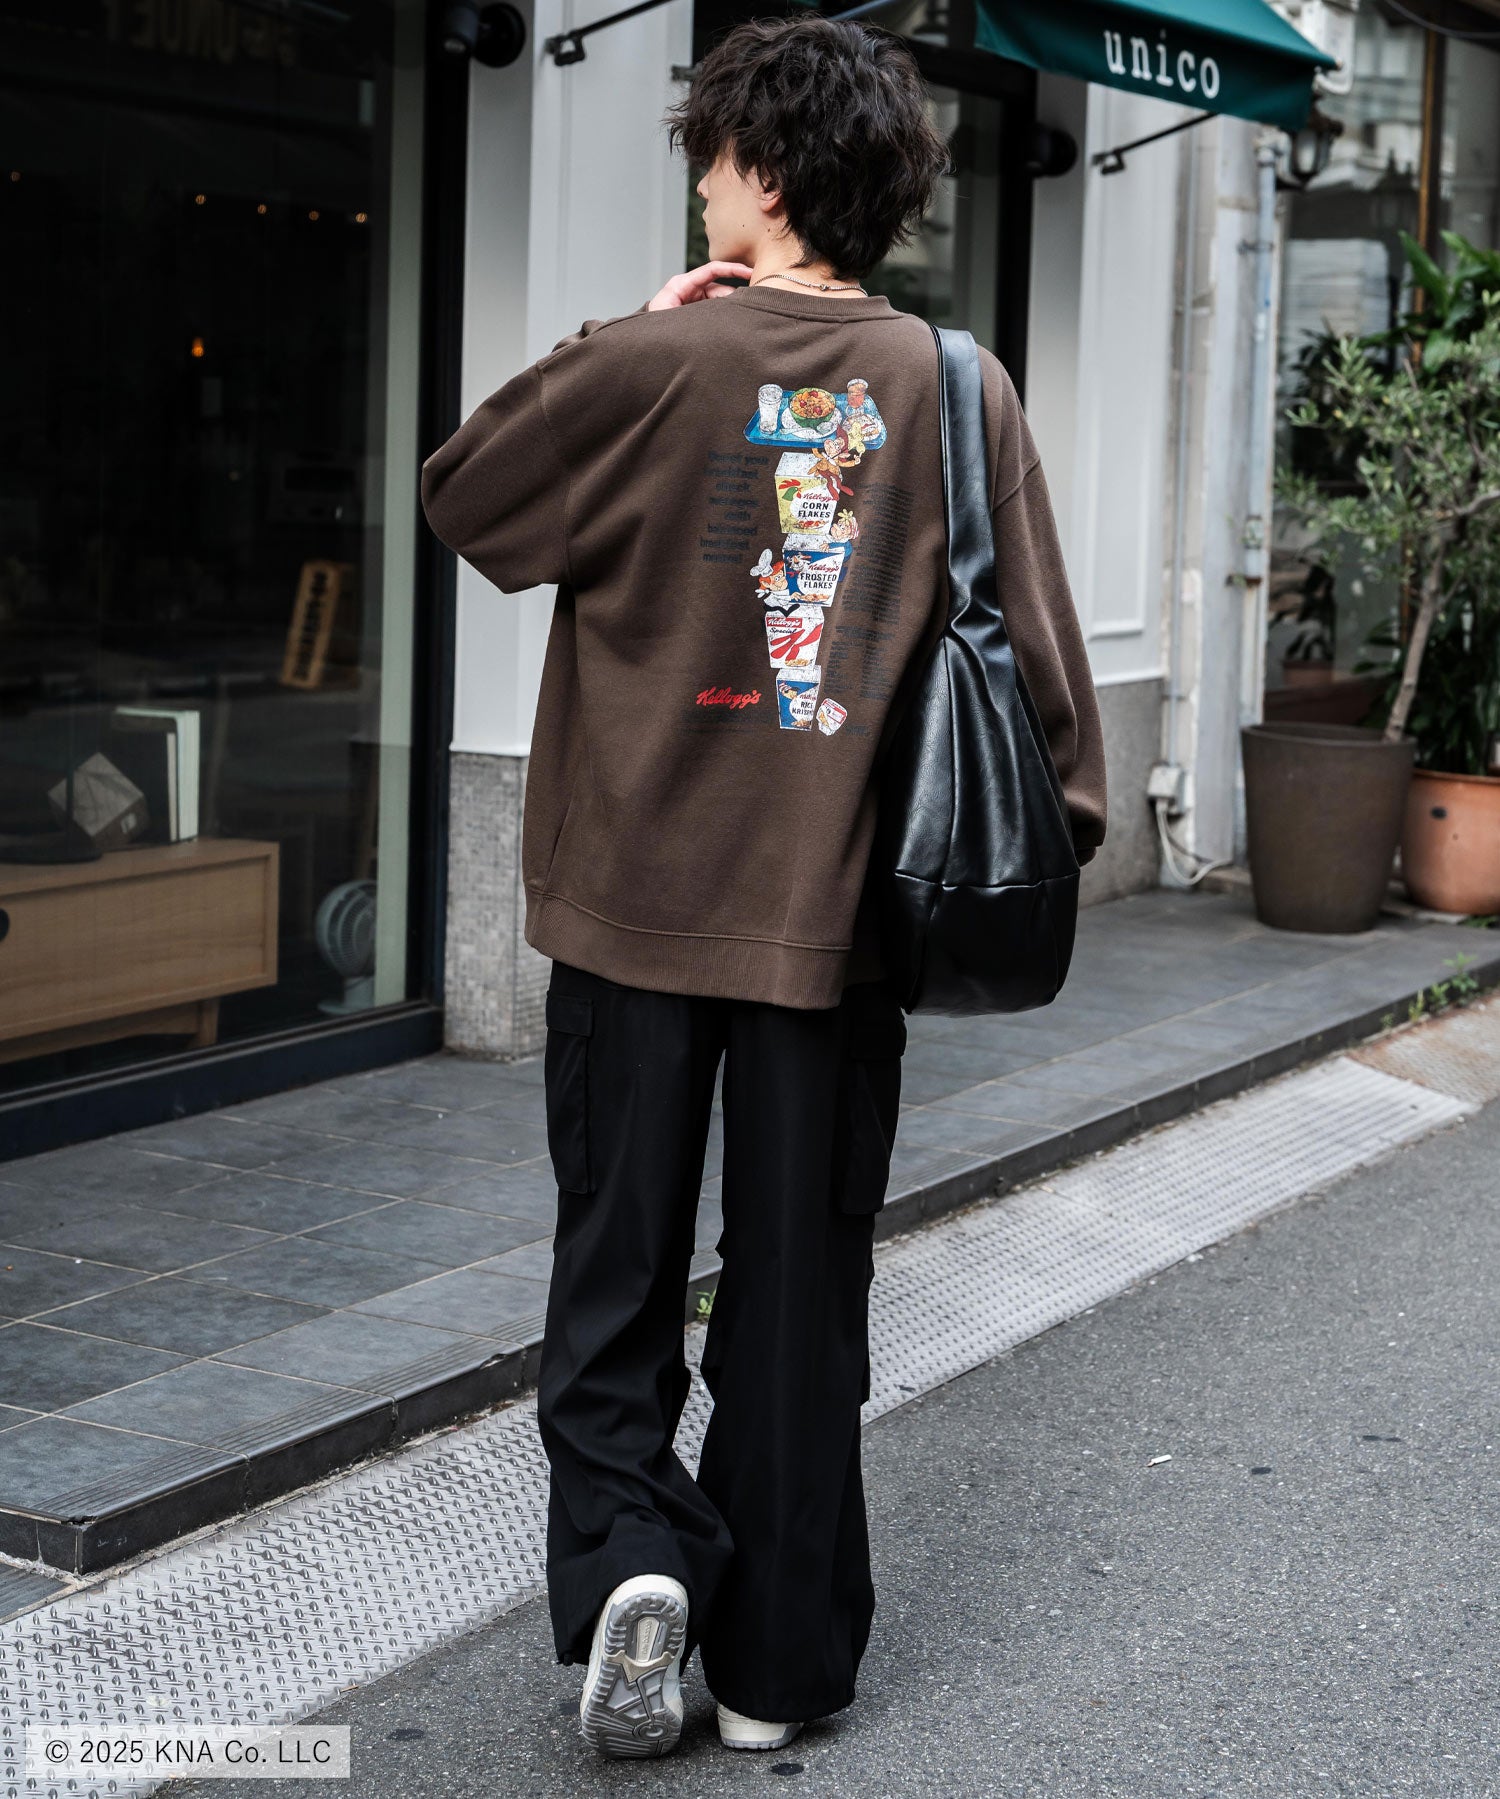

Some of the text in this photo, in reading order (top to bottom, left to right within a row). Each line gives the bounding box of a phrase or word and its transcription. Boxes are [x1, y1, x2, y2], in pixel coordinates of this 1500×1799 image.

[1103, 28, 1220, 100] unico
[802, 502, 829, 510] CORN
[798, 510, 831, 518] FLAKES
[808, 563, 839, 573] Kellogg's
[800, 572, 837, 582] FROSTED
[803, 580, 833, 589] FLAKES
[767, 618, 801, 628] Kellogg's
[696, 686, 762, 710] Kellogg's
